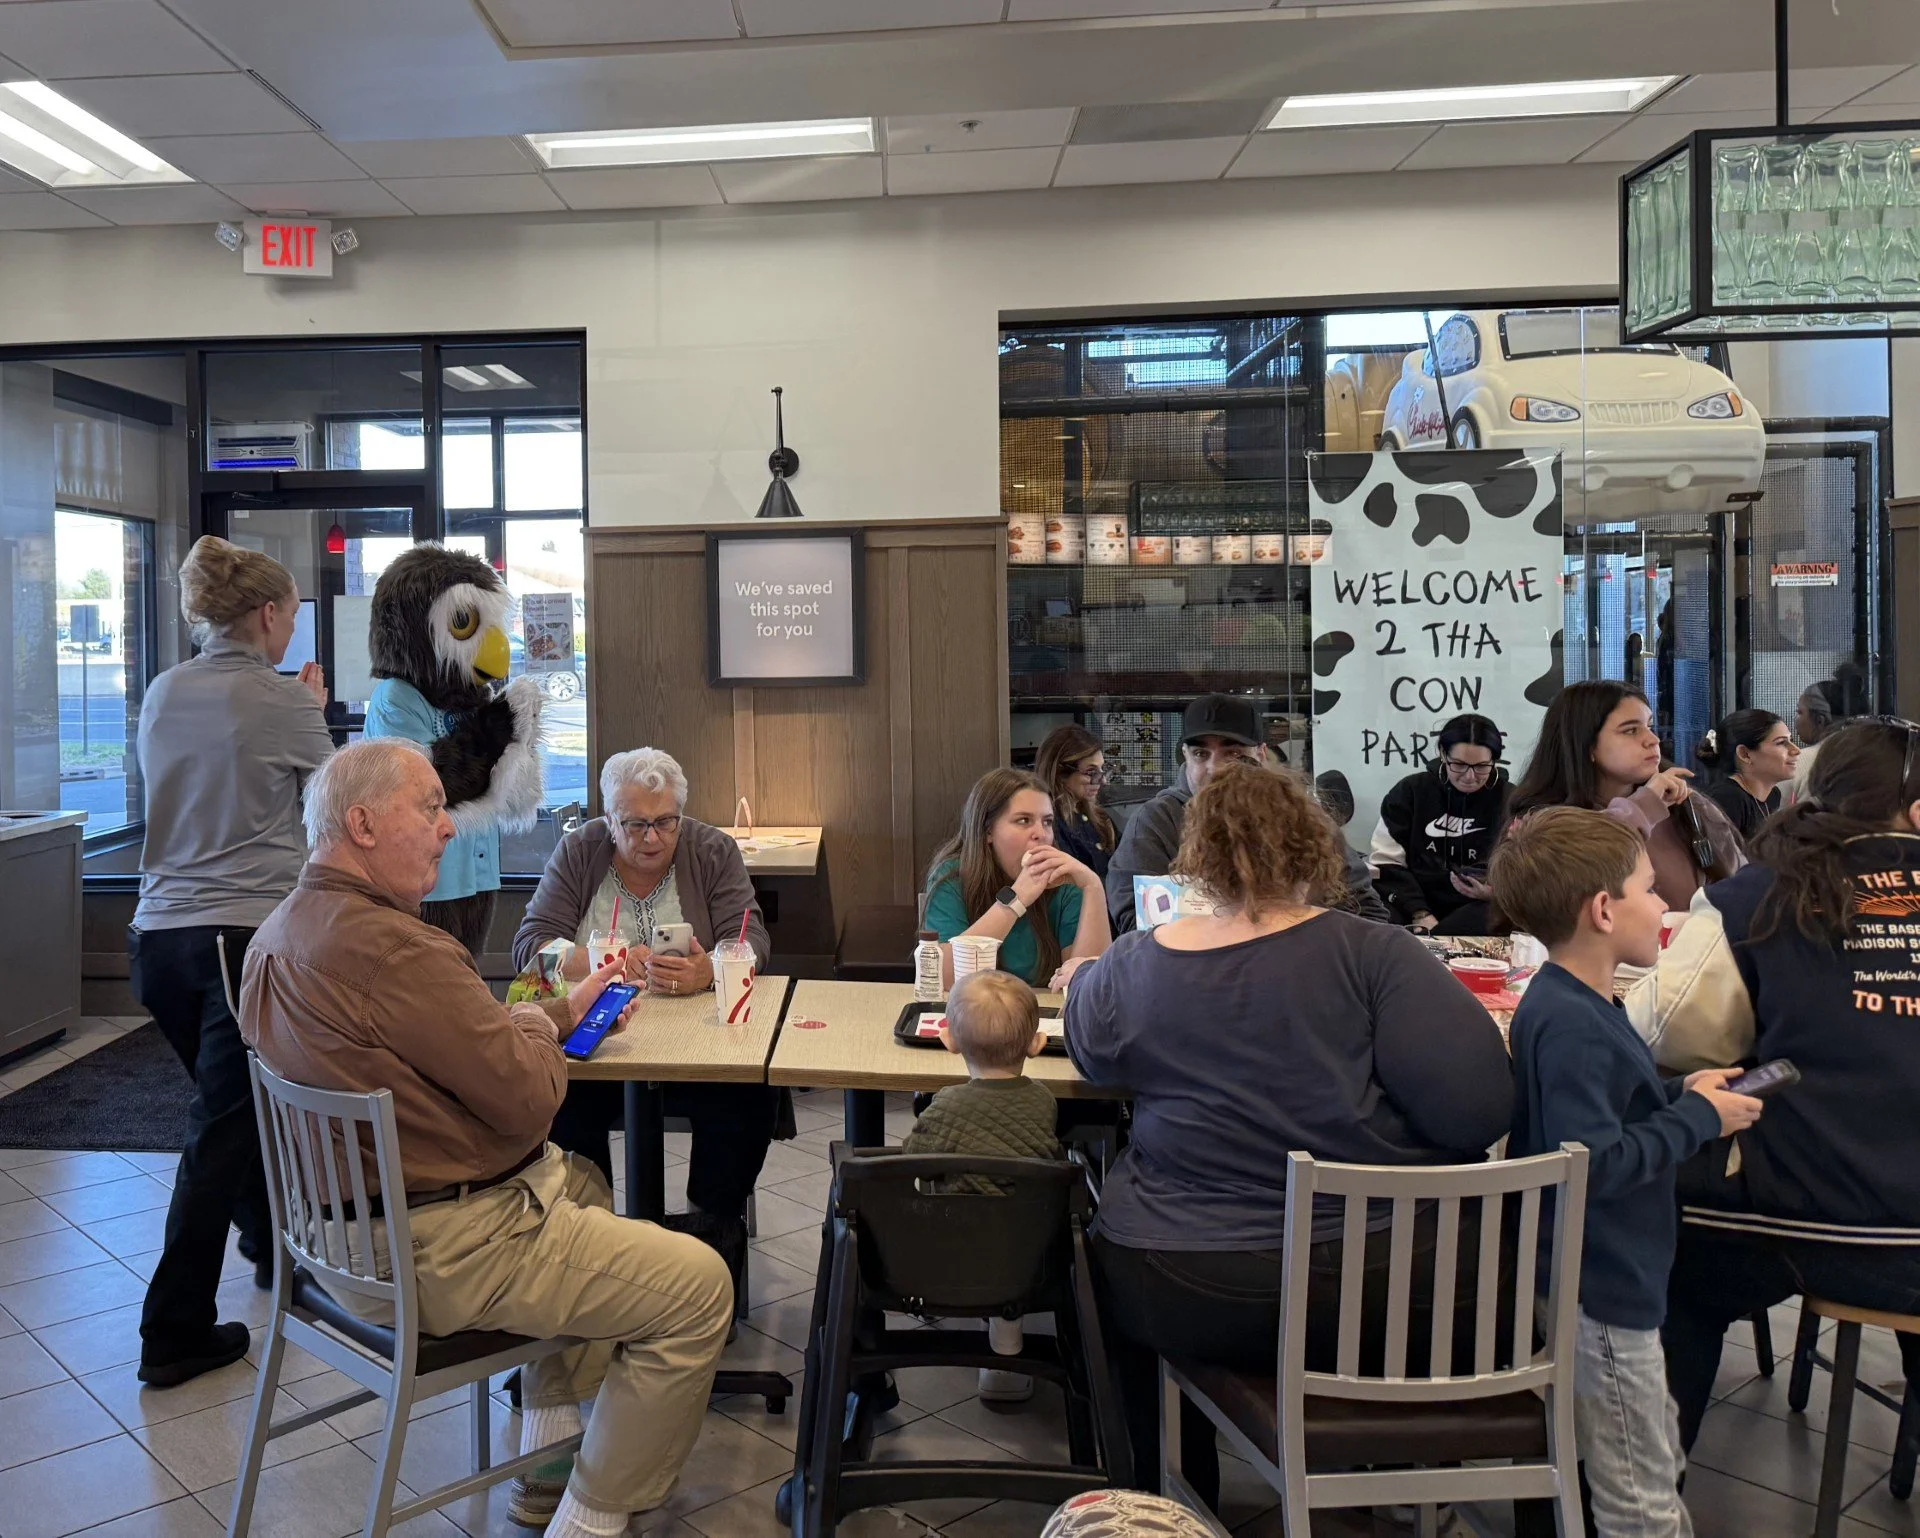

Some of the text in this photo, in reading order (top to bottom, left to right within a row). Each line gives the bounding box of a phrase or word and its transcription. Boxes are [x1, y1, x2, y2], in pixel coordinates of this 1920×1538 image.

[262, 224, 317, 268] EXIT
[1785, 564, 1831, 574] WARNING
[735, 580, 833, 596] We've saved
[1334, 567, 1542, 606] WELCOME
[750, 601, 819, 619] this spot
[756, 622, 813, 640] for you
[1375, 619, 1502, 659] 2 THA
[1390, 676, 1482, 713] COW
[1436, 813, 1475, 831] NIKE
[1426, 840, 1477, 860] AIR
[1857, 870, 1907, 889] THE
[1856, 924, 1885, 935] THE
[1843, 937, 1906, 950] MADISON
[1853, 969, 1917, 982] The World's
[1852, 989, 1883, 1012] TO
